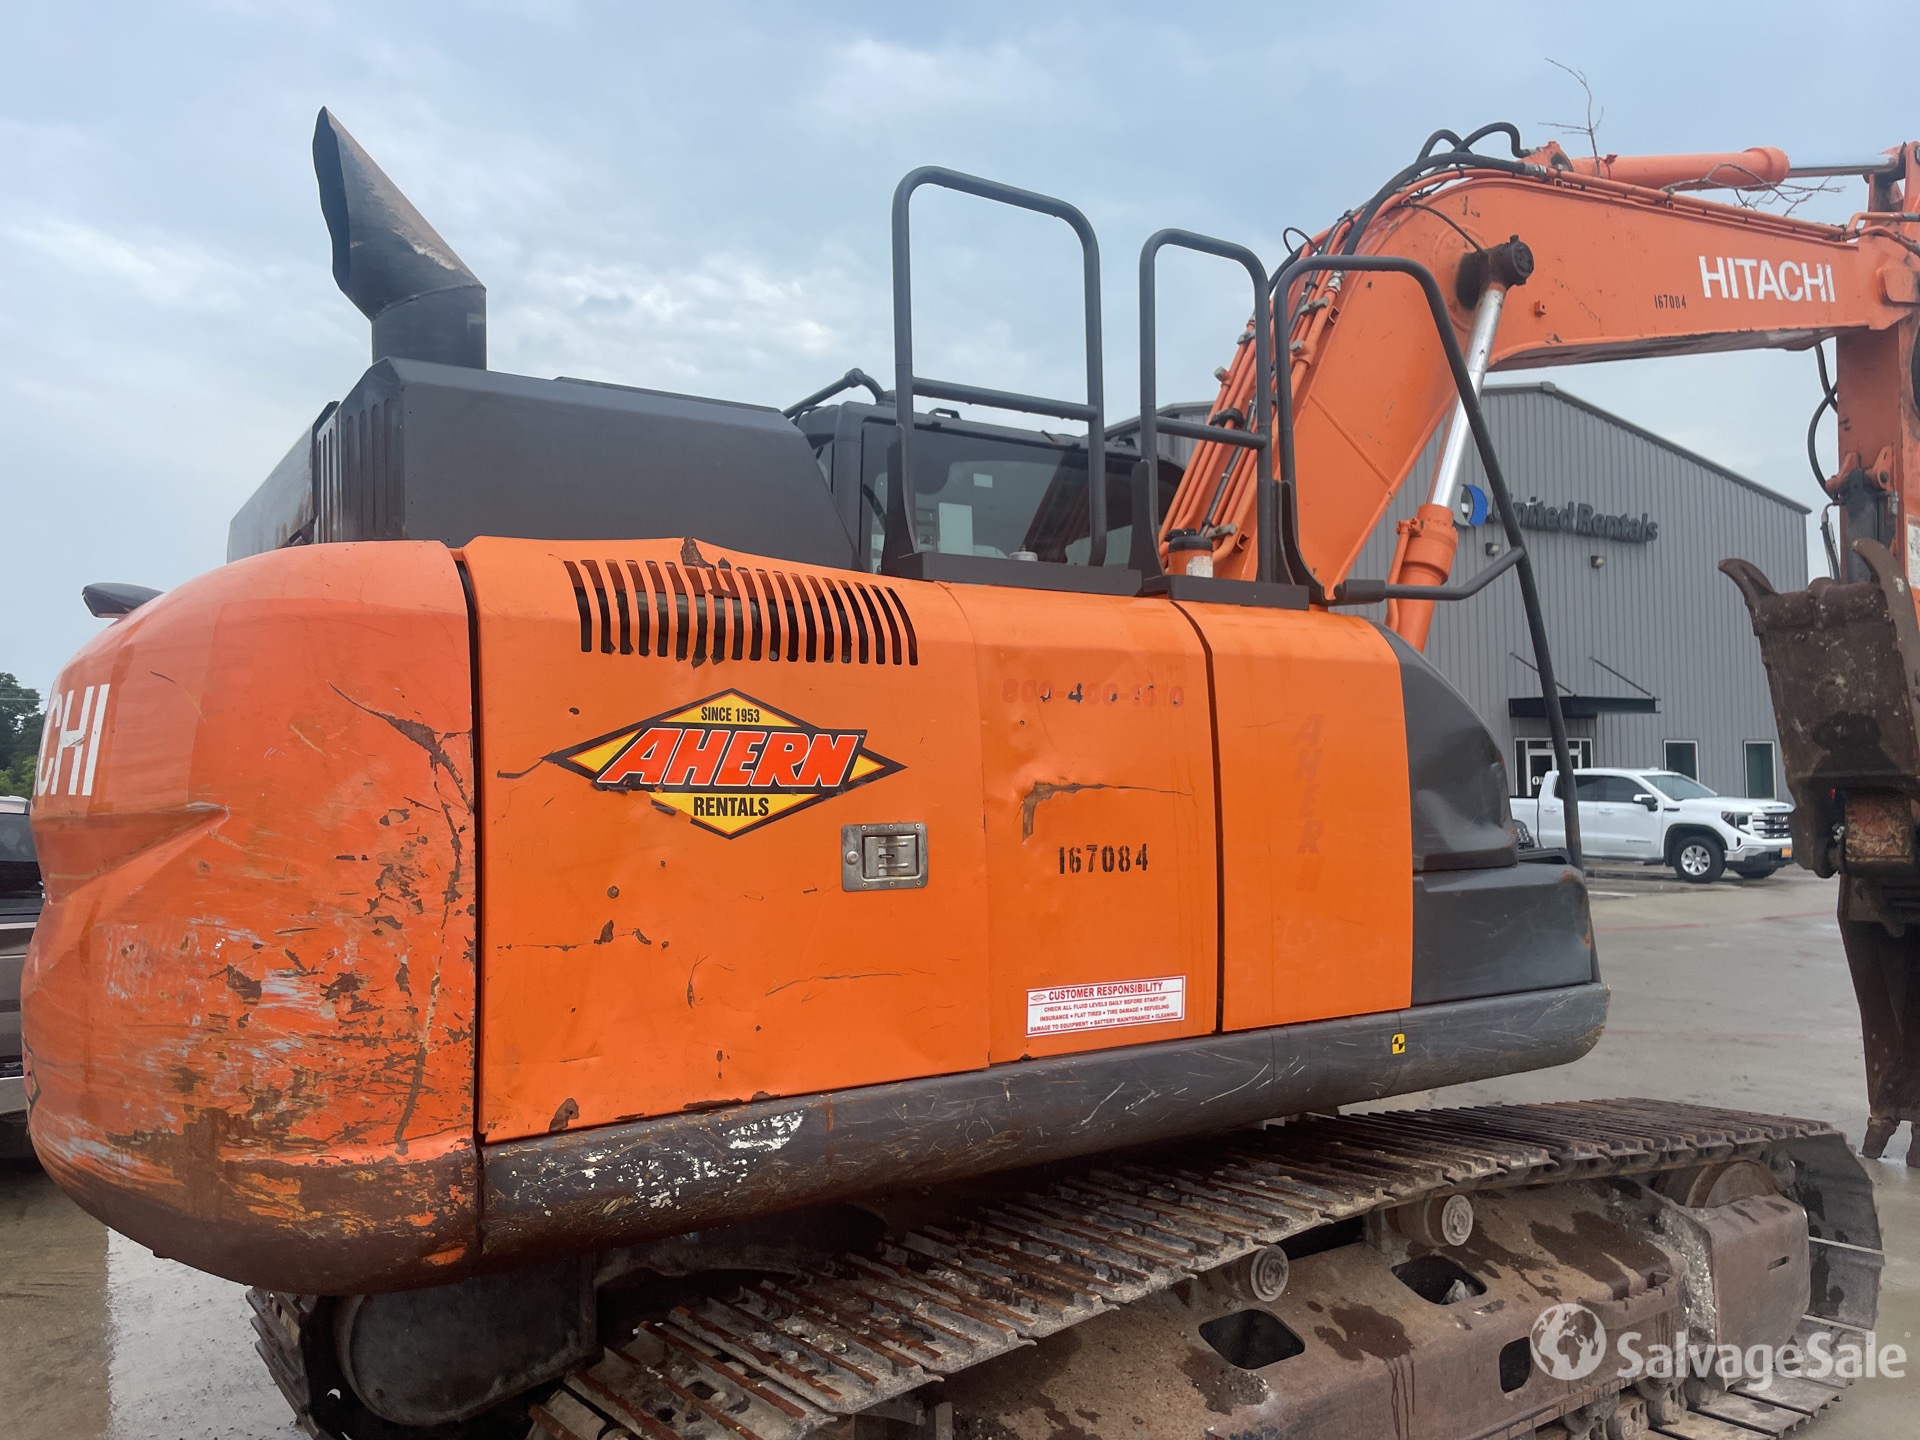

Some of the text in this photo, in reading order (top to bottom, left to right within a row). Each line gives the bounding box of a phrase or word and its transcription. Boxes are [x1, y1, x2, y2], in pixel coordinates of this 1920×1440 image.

[1699, 255, 1836, 303] HITACHI
[1654, 294, 1687, 310] 167084
[1576, 503, 1658, 541] Rentals
[701, 706, 760, 724] SINCE 1953
[596, 728, 859, 787] AHERN
[693, 797, 770, 817] RENTALS
[1058, 843, 1148, 875] 167084
[1049, 982, 1163, 1001] CUSTOMER RESPONSIBILITY
[1039, 1013, 1069, 1022] INSURANCE
[1060, 1021, 1089, 1029] EQUIPMENT
[1117, 1014, 1151, 1023] MAINTENANCE
[1155, 1011, 1178, 1019] CLEANING
